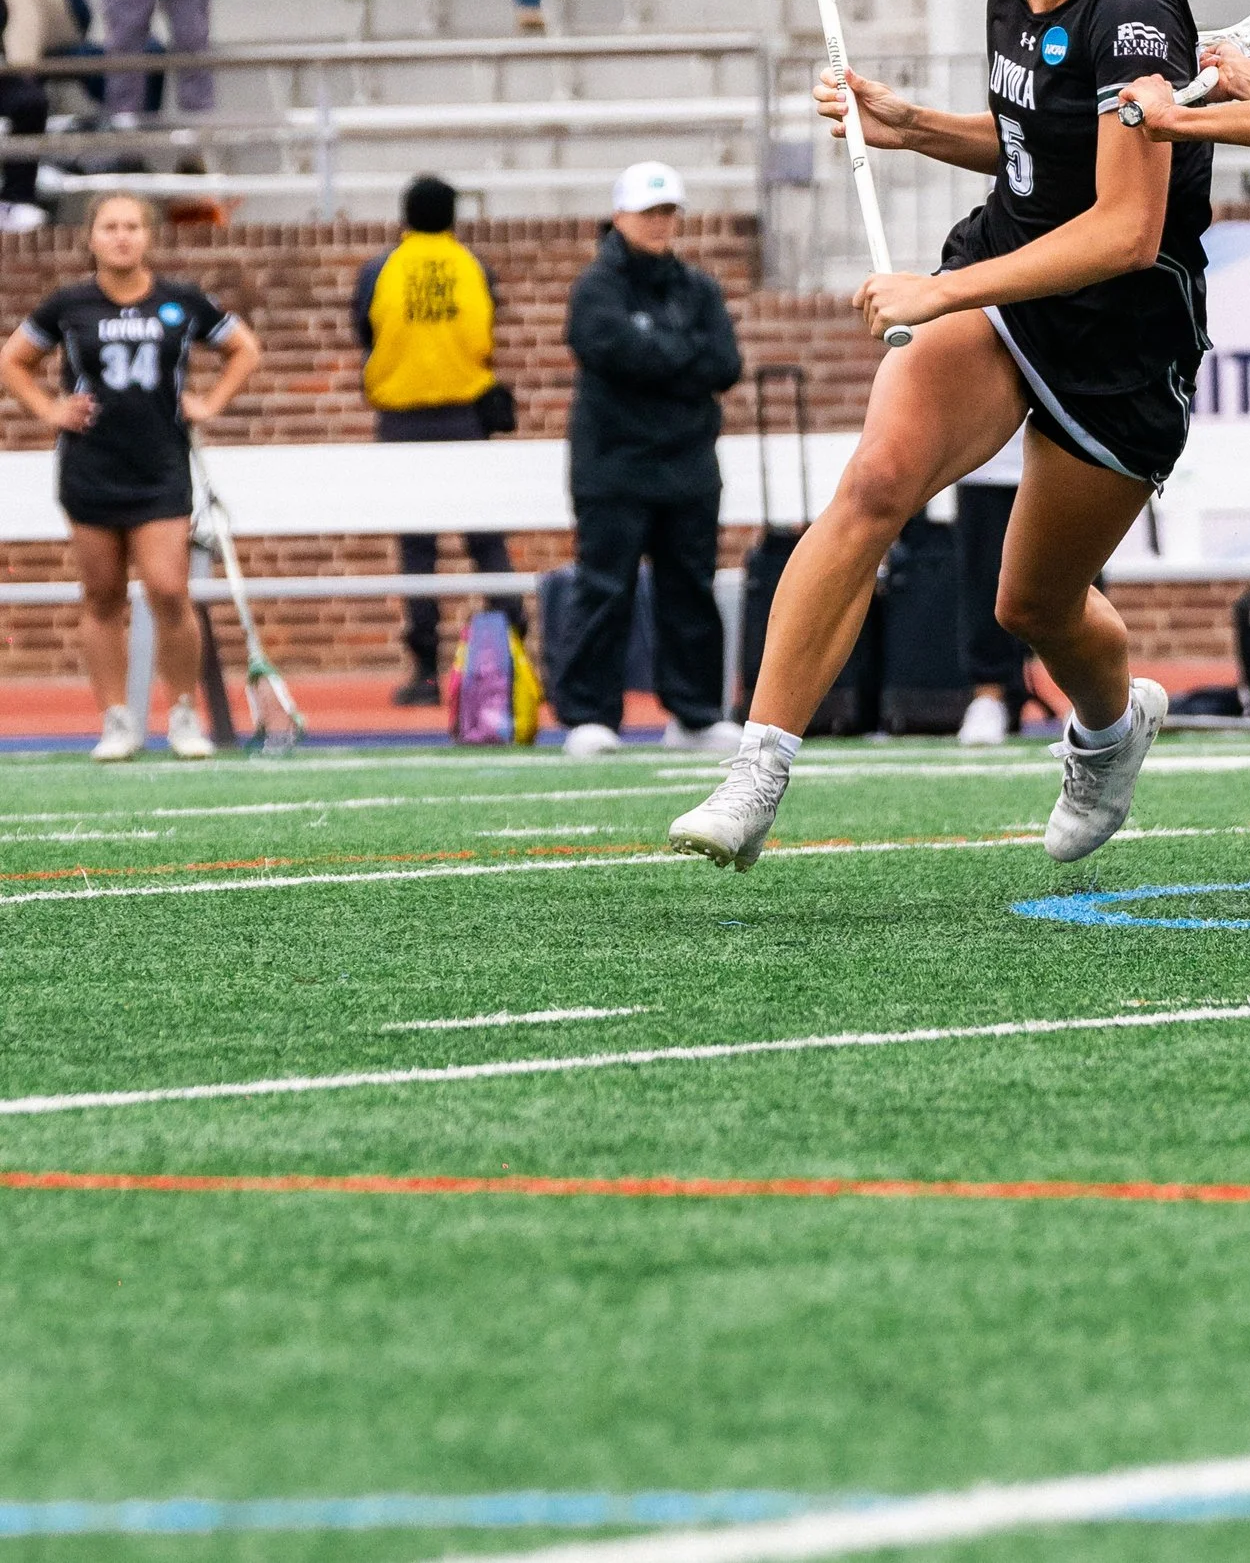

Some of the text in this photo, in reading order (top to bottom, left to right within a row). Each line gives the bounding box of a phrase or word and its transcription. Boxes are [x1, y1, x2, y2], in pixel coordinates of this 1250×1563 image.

[1044, 43, 1067, 56] NCAA
[1113, 38, 1168, 52] PATRIOT
[1113, 47, 1168, 61] LEAGUE
[990, 51, 1036, 110] LOYOLA
[998, 114, 1034, 197] 5
[98, 317, 165, 341] LOYOLA
[100, 343, 160, 390] 34
